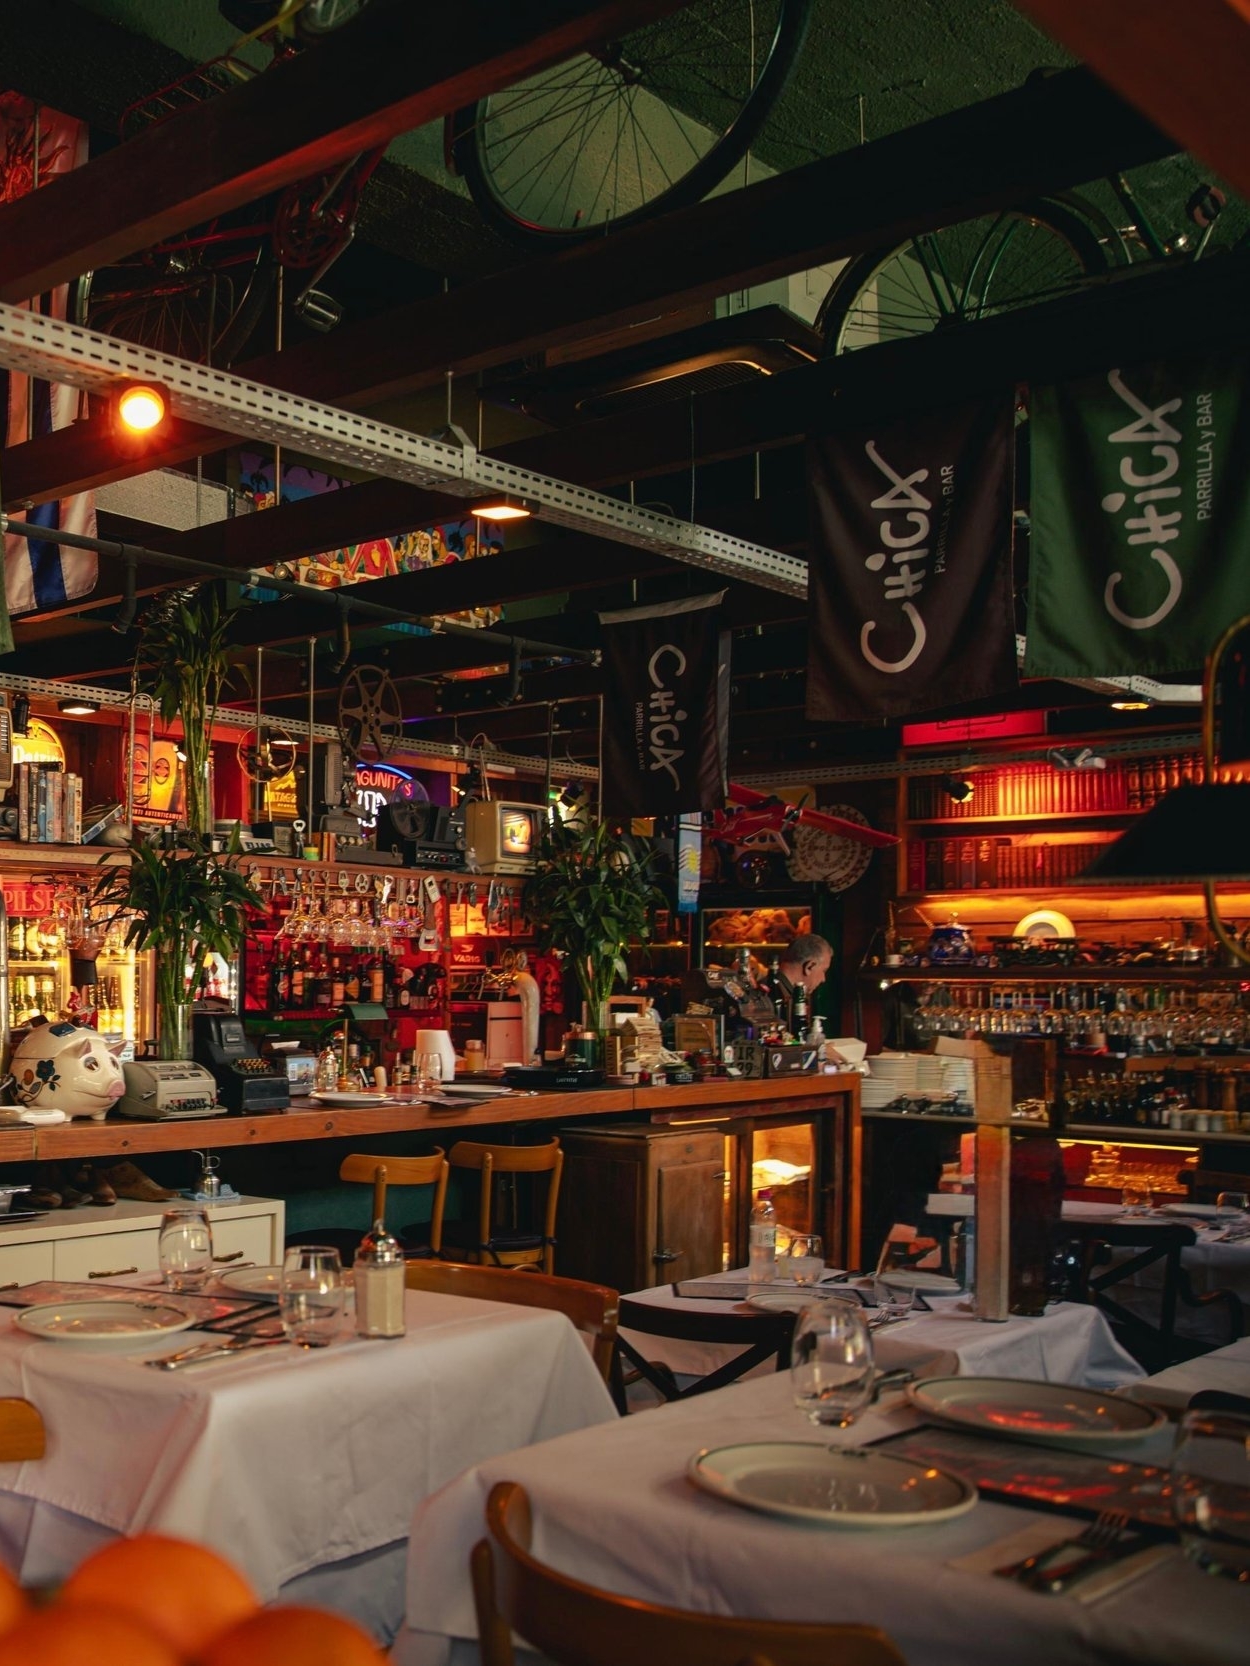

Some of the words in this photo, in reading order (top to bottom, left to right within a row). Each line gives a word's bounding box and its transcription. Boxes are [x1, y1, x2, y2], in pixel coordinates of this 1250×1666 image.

[1196, 392, 1214, 426] BAR
[939, 464, 956, 495] BAR
[1196, 439, 1214, 522] PARRILLA
